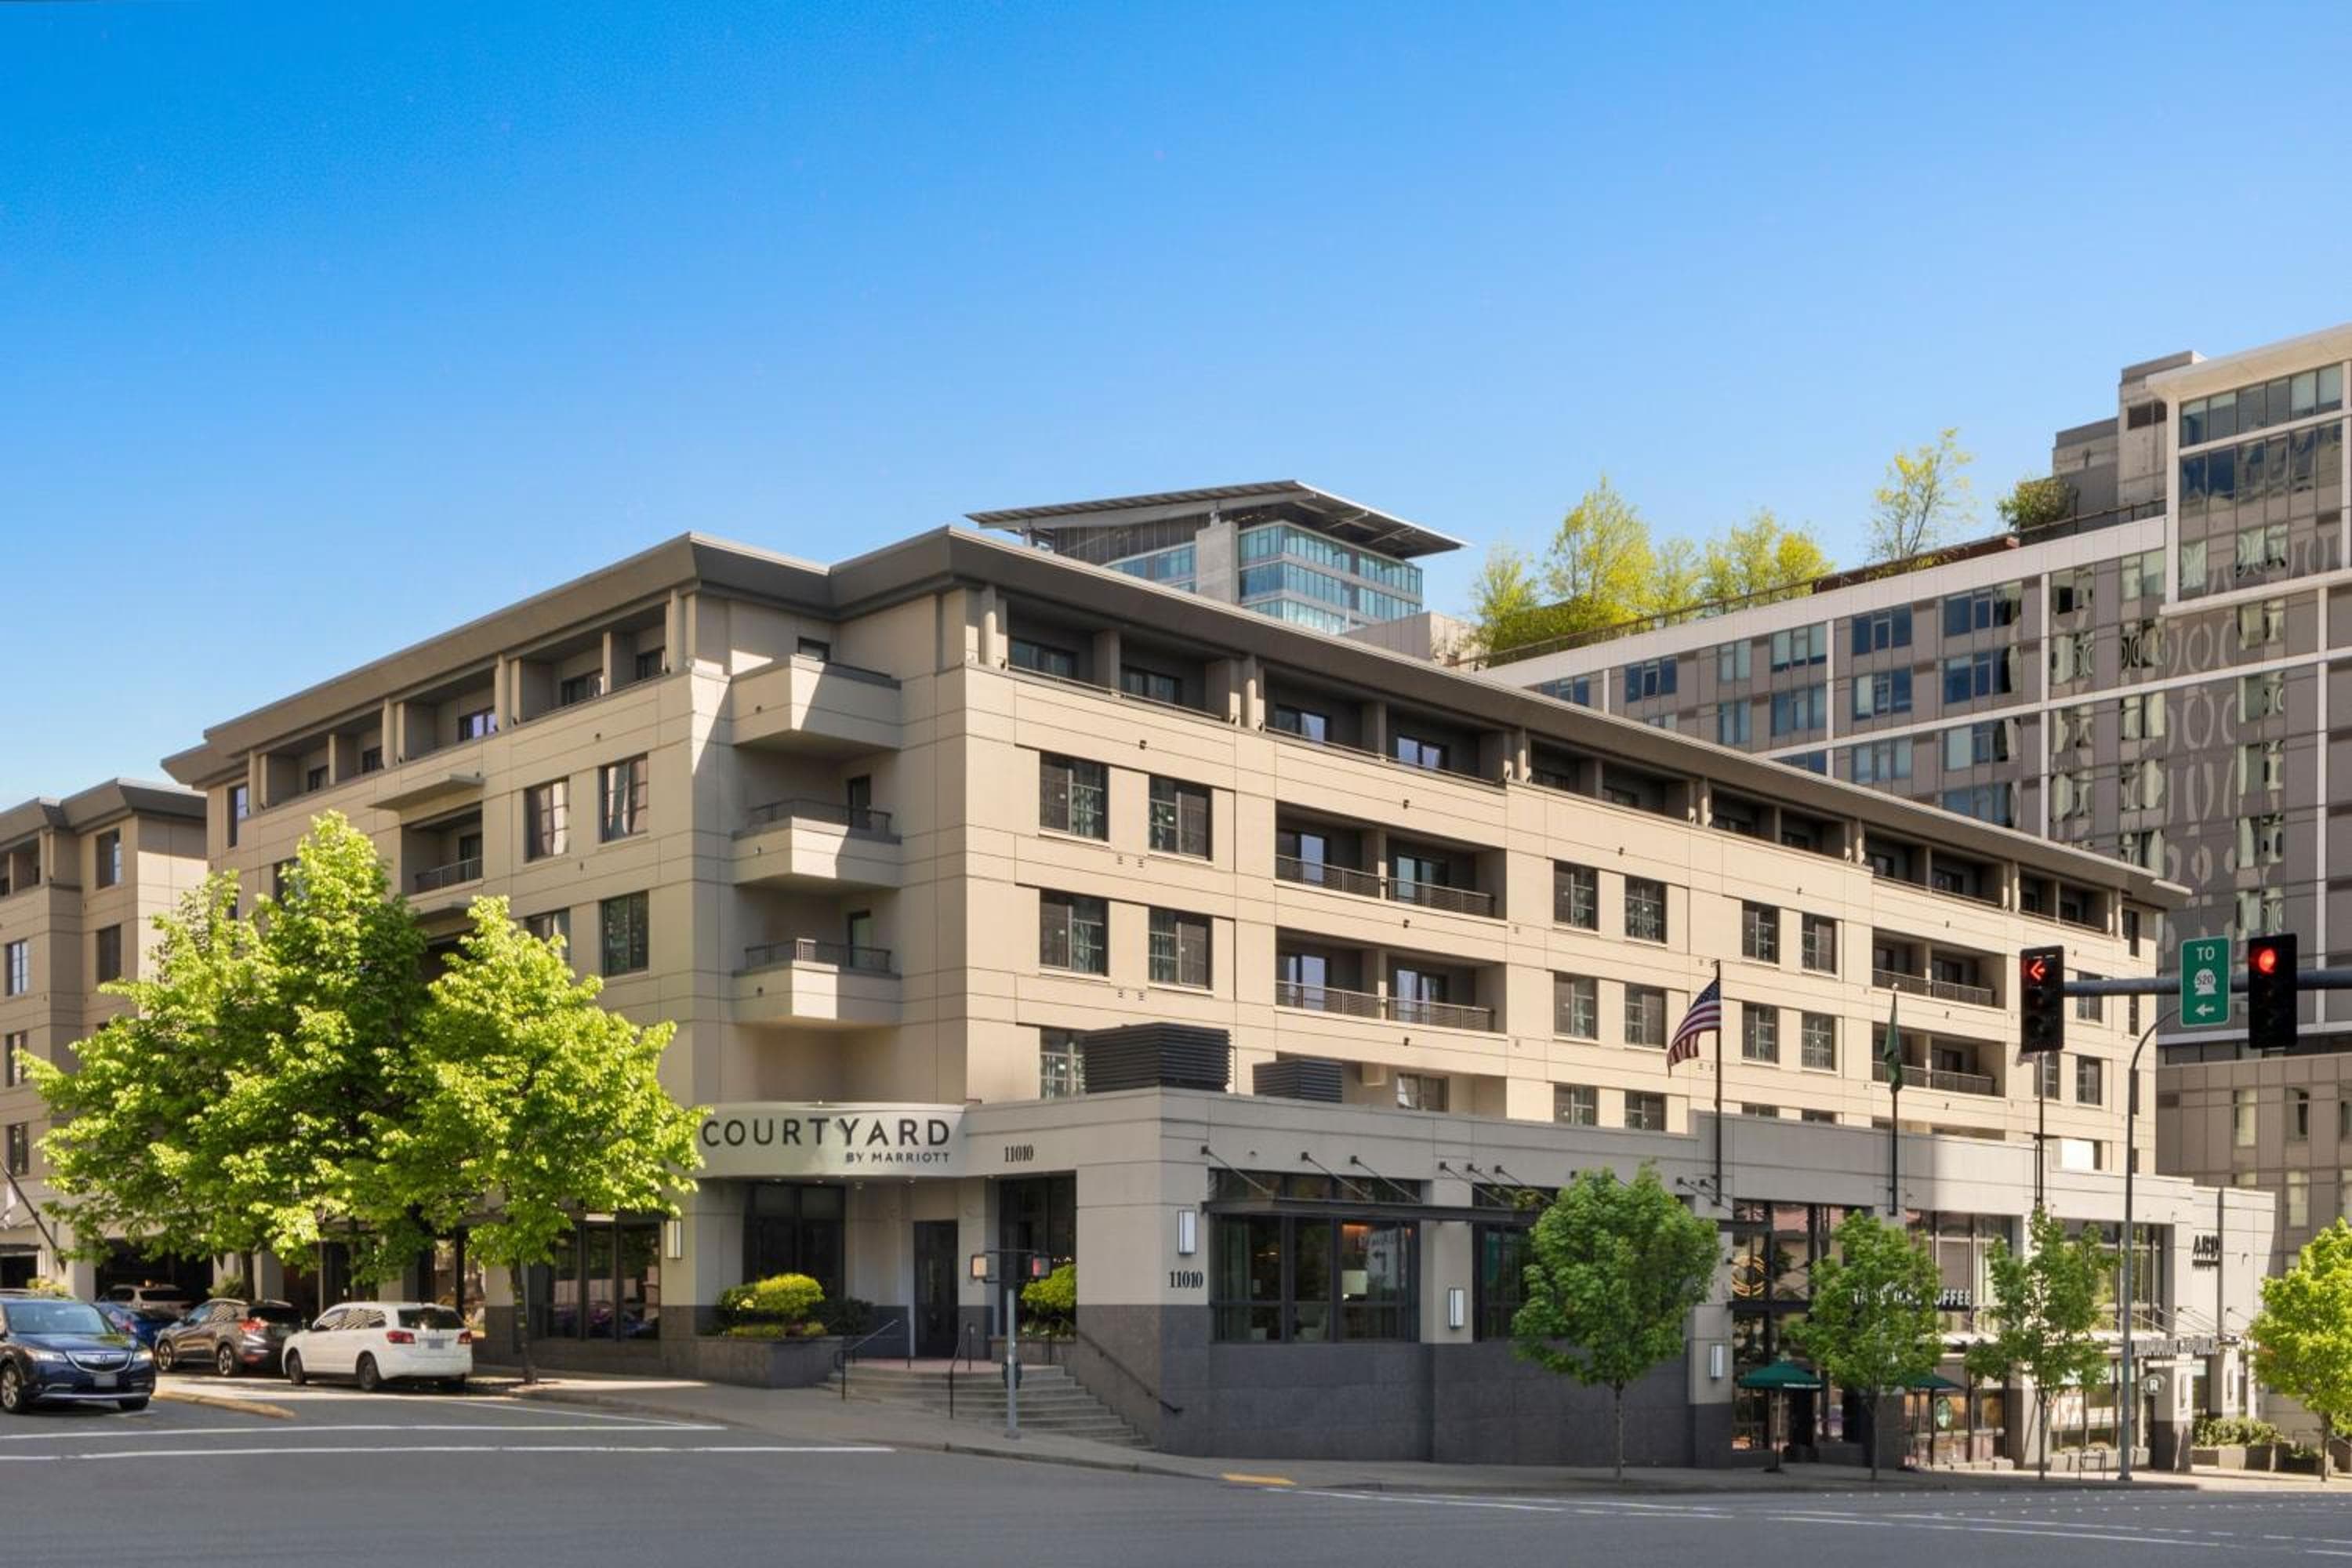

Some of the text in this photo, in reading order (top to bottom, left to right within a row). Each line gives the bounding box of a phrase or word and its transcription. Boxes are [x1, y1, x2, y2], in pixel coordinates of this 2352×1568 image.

[2196, 946, 2215, 961] TO
[2196, 975, 2213, 985] 520
[702, 1118, 950, 1147] COURTYARD
[845, 1152, 950, 1163] BY MARRIOTT
[1004, 1145, 1034, 1162] 11010
[1170, 1270, 1203, 1288] 11010
[1928, 1288, 1970, 1305] OFFEE
